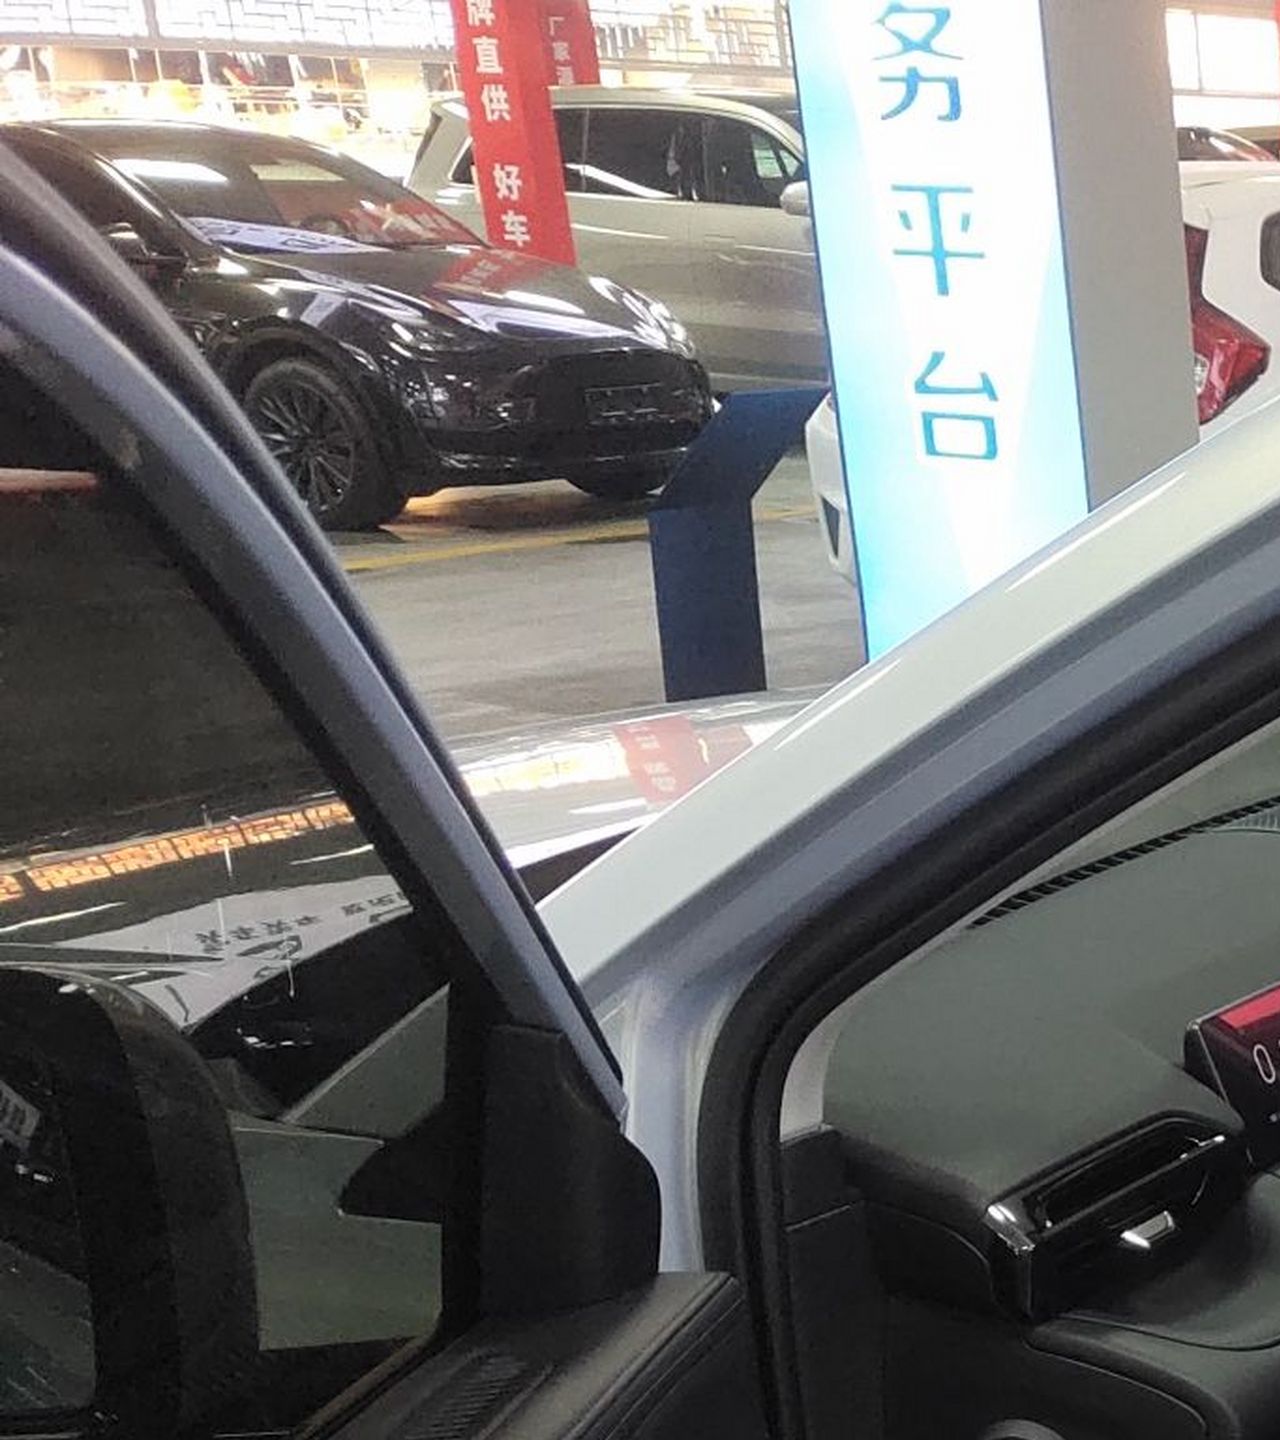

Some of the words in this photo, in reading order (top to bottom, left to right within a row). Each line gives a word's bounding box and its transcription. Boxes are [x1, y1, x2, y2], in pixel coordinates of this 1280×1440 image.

[492, 162, 531, 247] 好车
[872, 3, 1000, 460] 务平台
